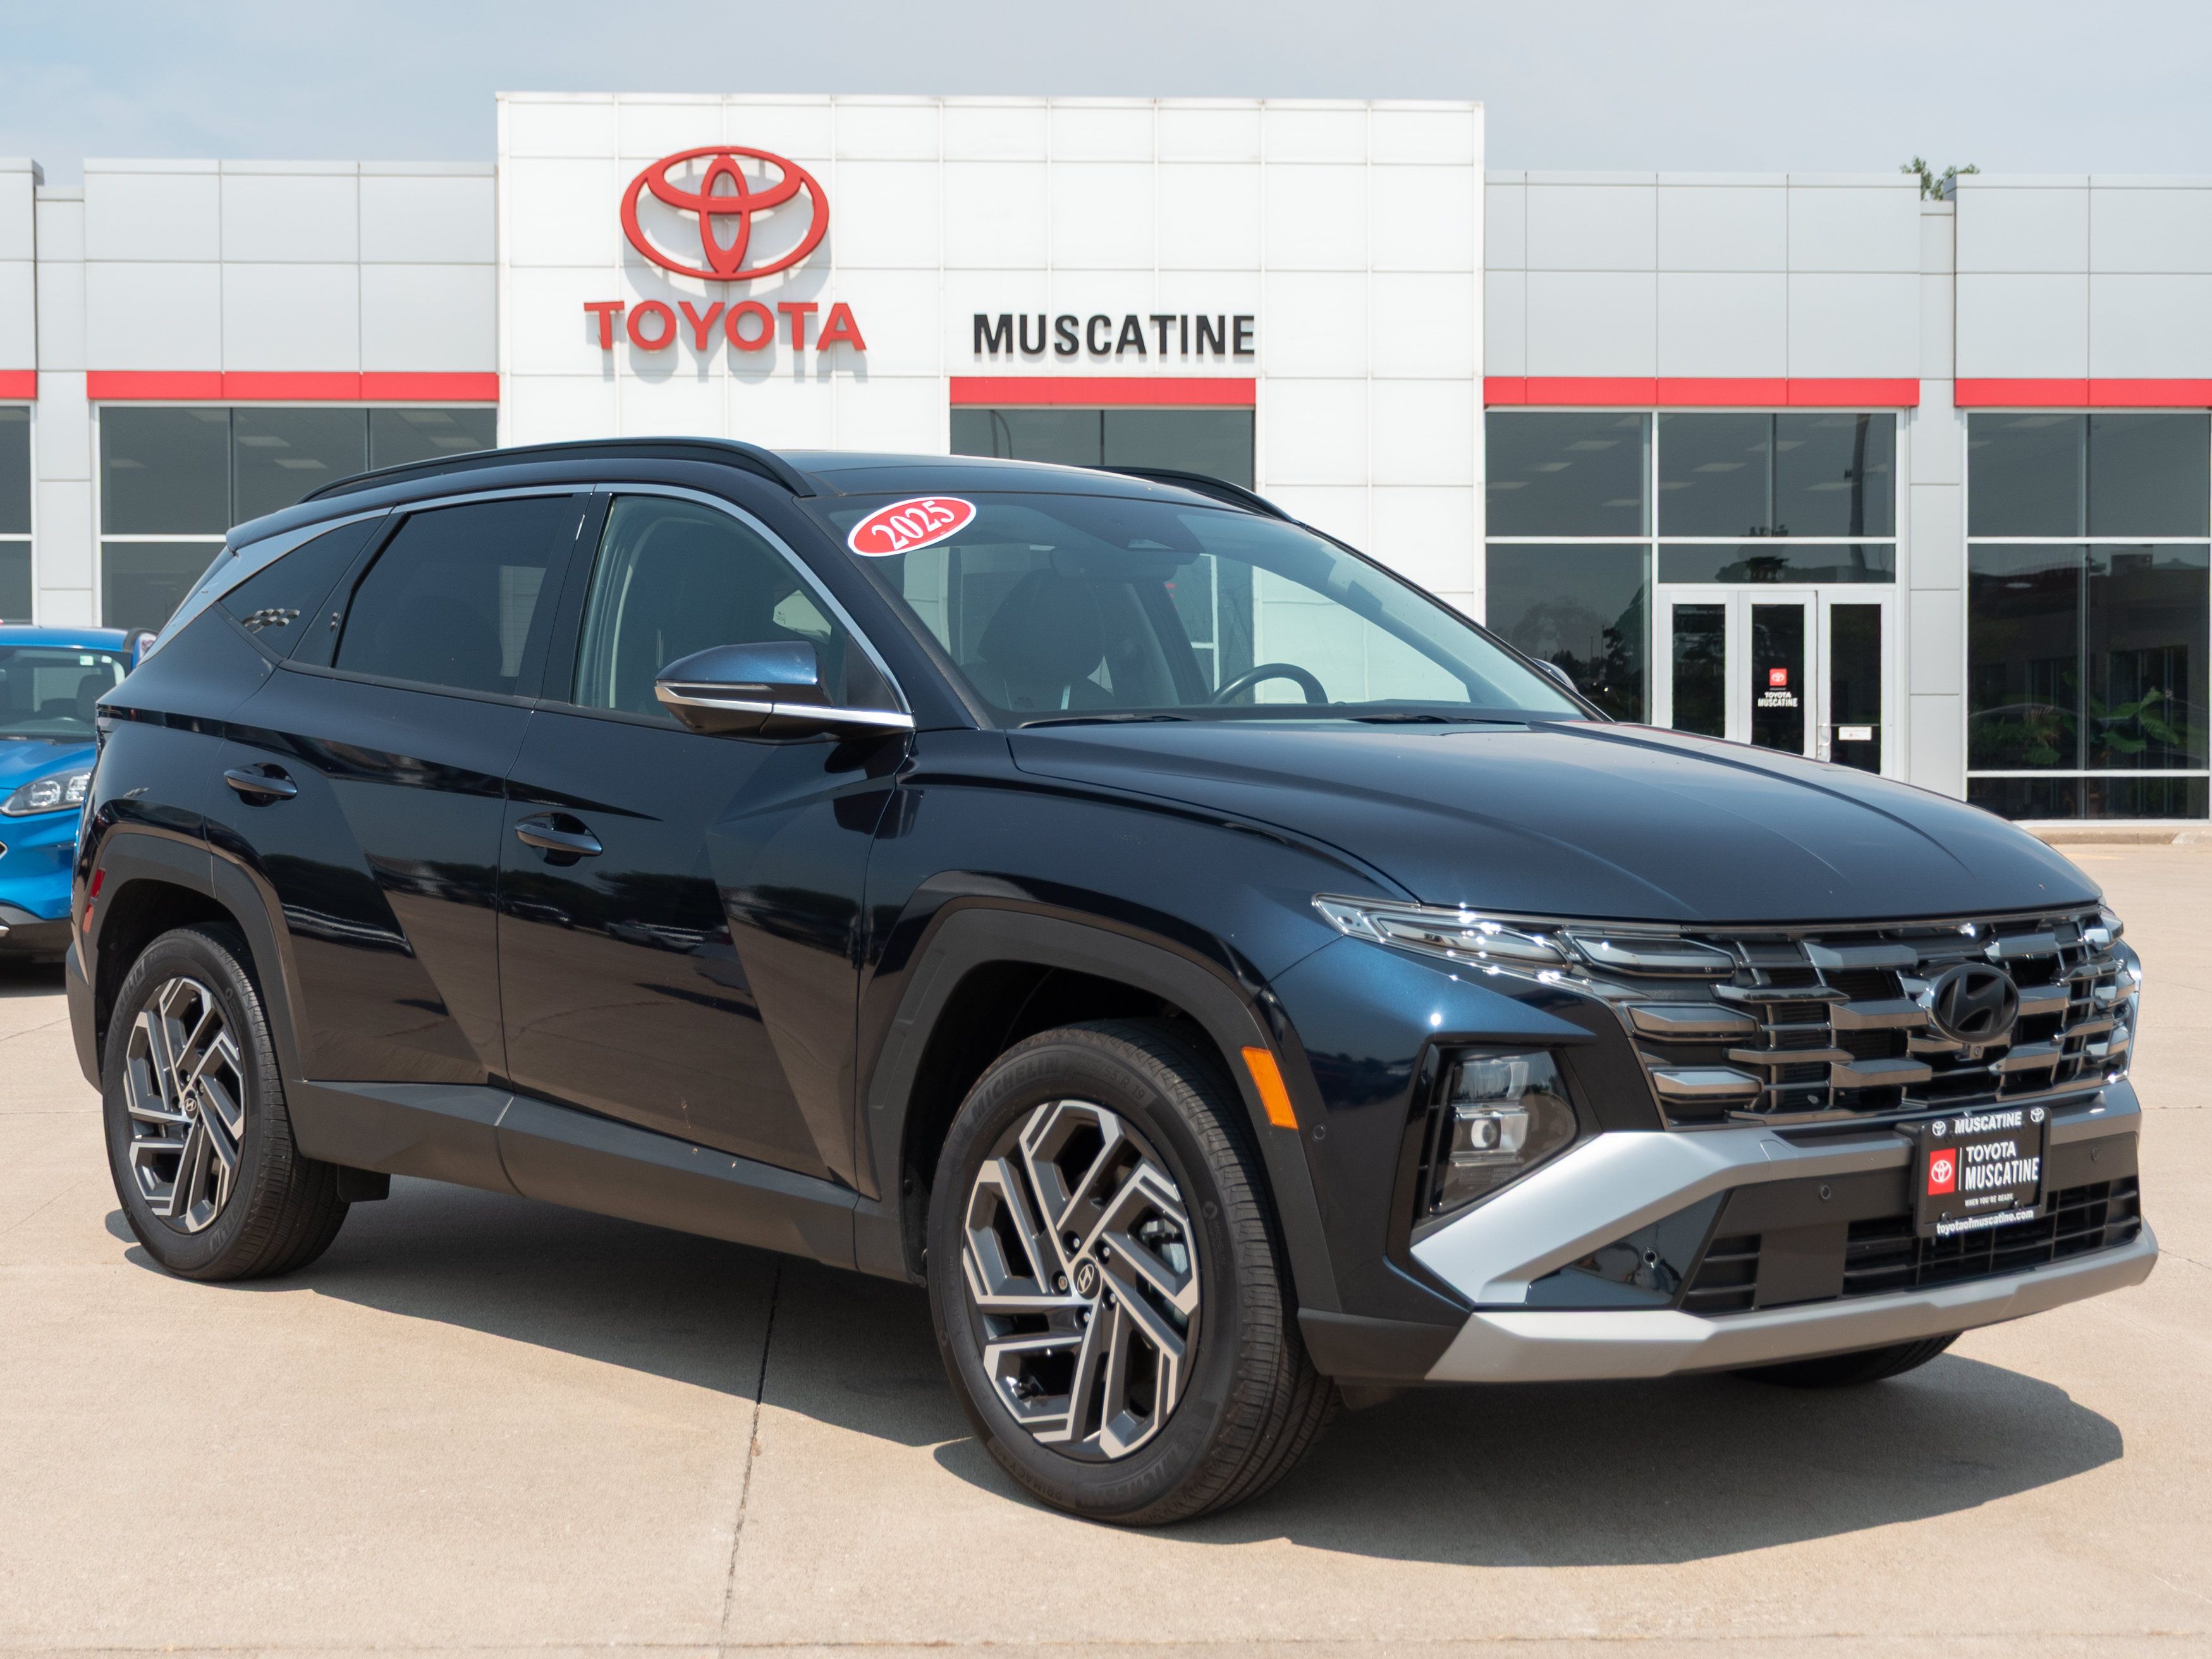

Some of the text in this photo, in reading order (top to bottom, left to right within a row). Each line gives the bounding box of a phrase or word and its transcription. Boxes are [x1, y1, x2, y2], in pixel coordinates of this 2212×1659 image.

[584, 300, 867, 351] TOYOTA
[974, 314, 1256, 355] MUSCATINE
[871, 499, 956, 549] 2025
[1757, 697, 1799, 707] MUSCATINE
[970, 1056, 1060, 1125] MICHELIN
[1132, 1085, 1146, 1100] 19
[1954, 1111, 2023, 1134] MUSCATINE
[1965, 1141, 2017, 1163] TOYOTA
[1965, 1158, 2039, 1191] MUSCATINE
[1936, 1209, 2034, 1235] toyotaofmuscatine.com
[1010, 1462, 1063, 1502] PRIMACY
